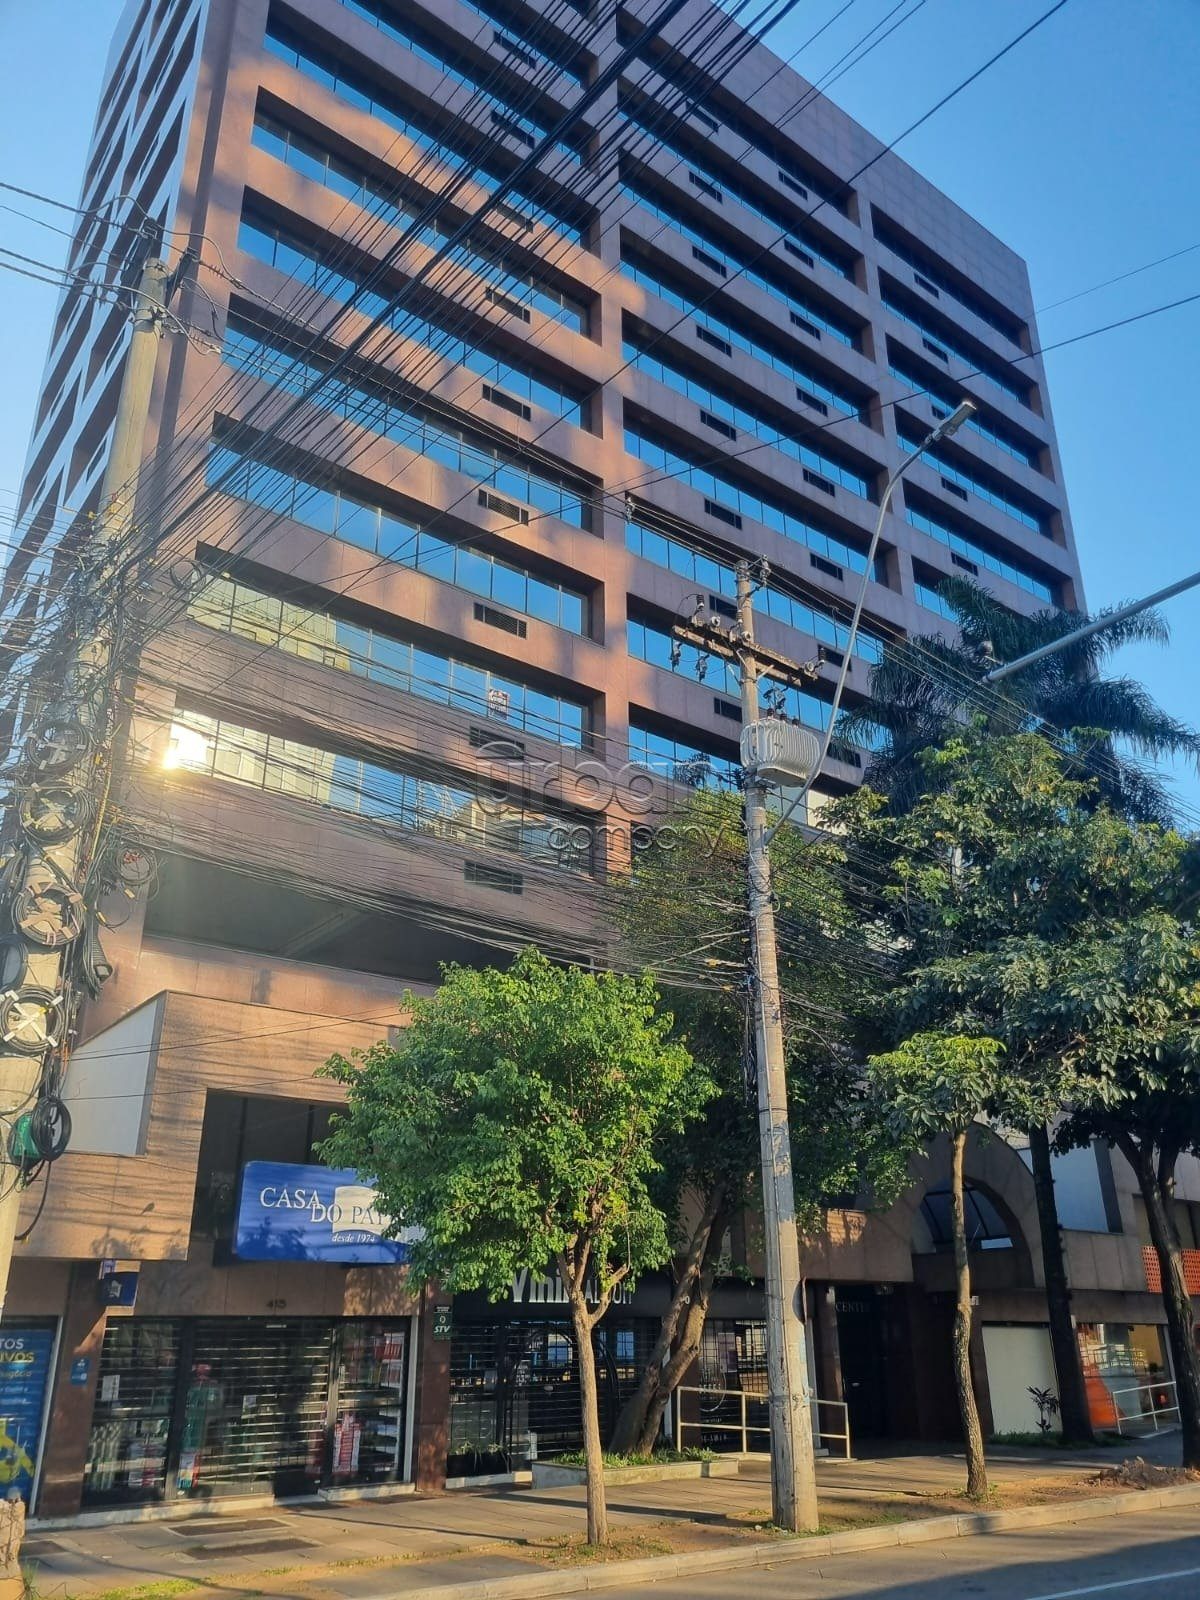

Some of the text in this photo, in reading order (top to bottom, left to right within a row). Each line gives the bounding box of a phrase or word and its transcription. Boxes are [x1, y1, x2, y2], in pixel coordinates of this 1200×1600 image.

[259, 1187, 322, 1209] CASA
[310, 1202, 342, 1223] DO
[331, 1233, 355, 1242] desde
[433, 1325, 451, 1334] STV
